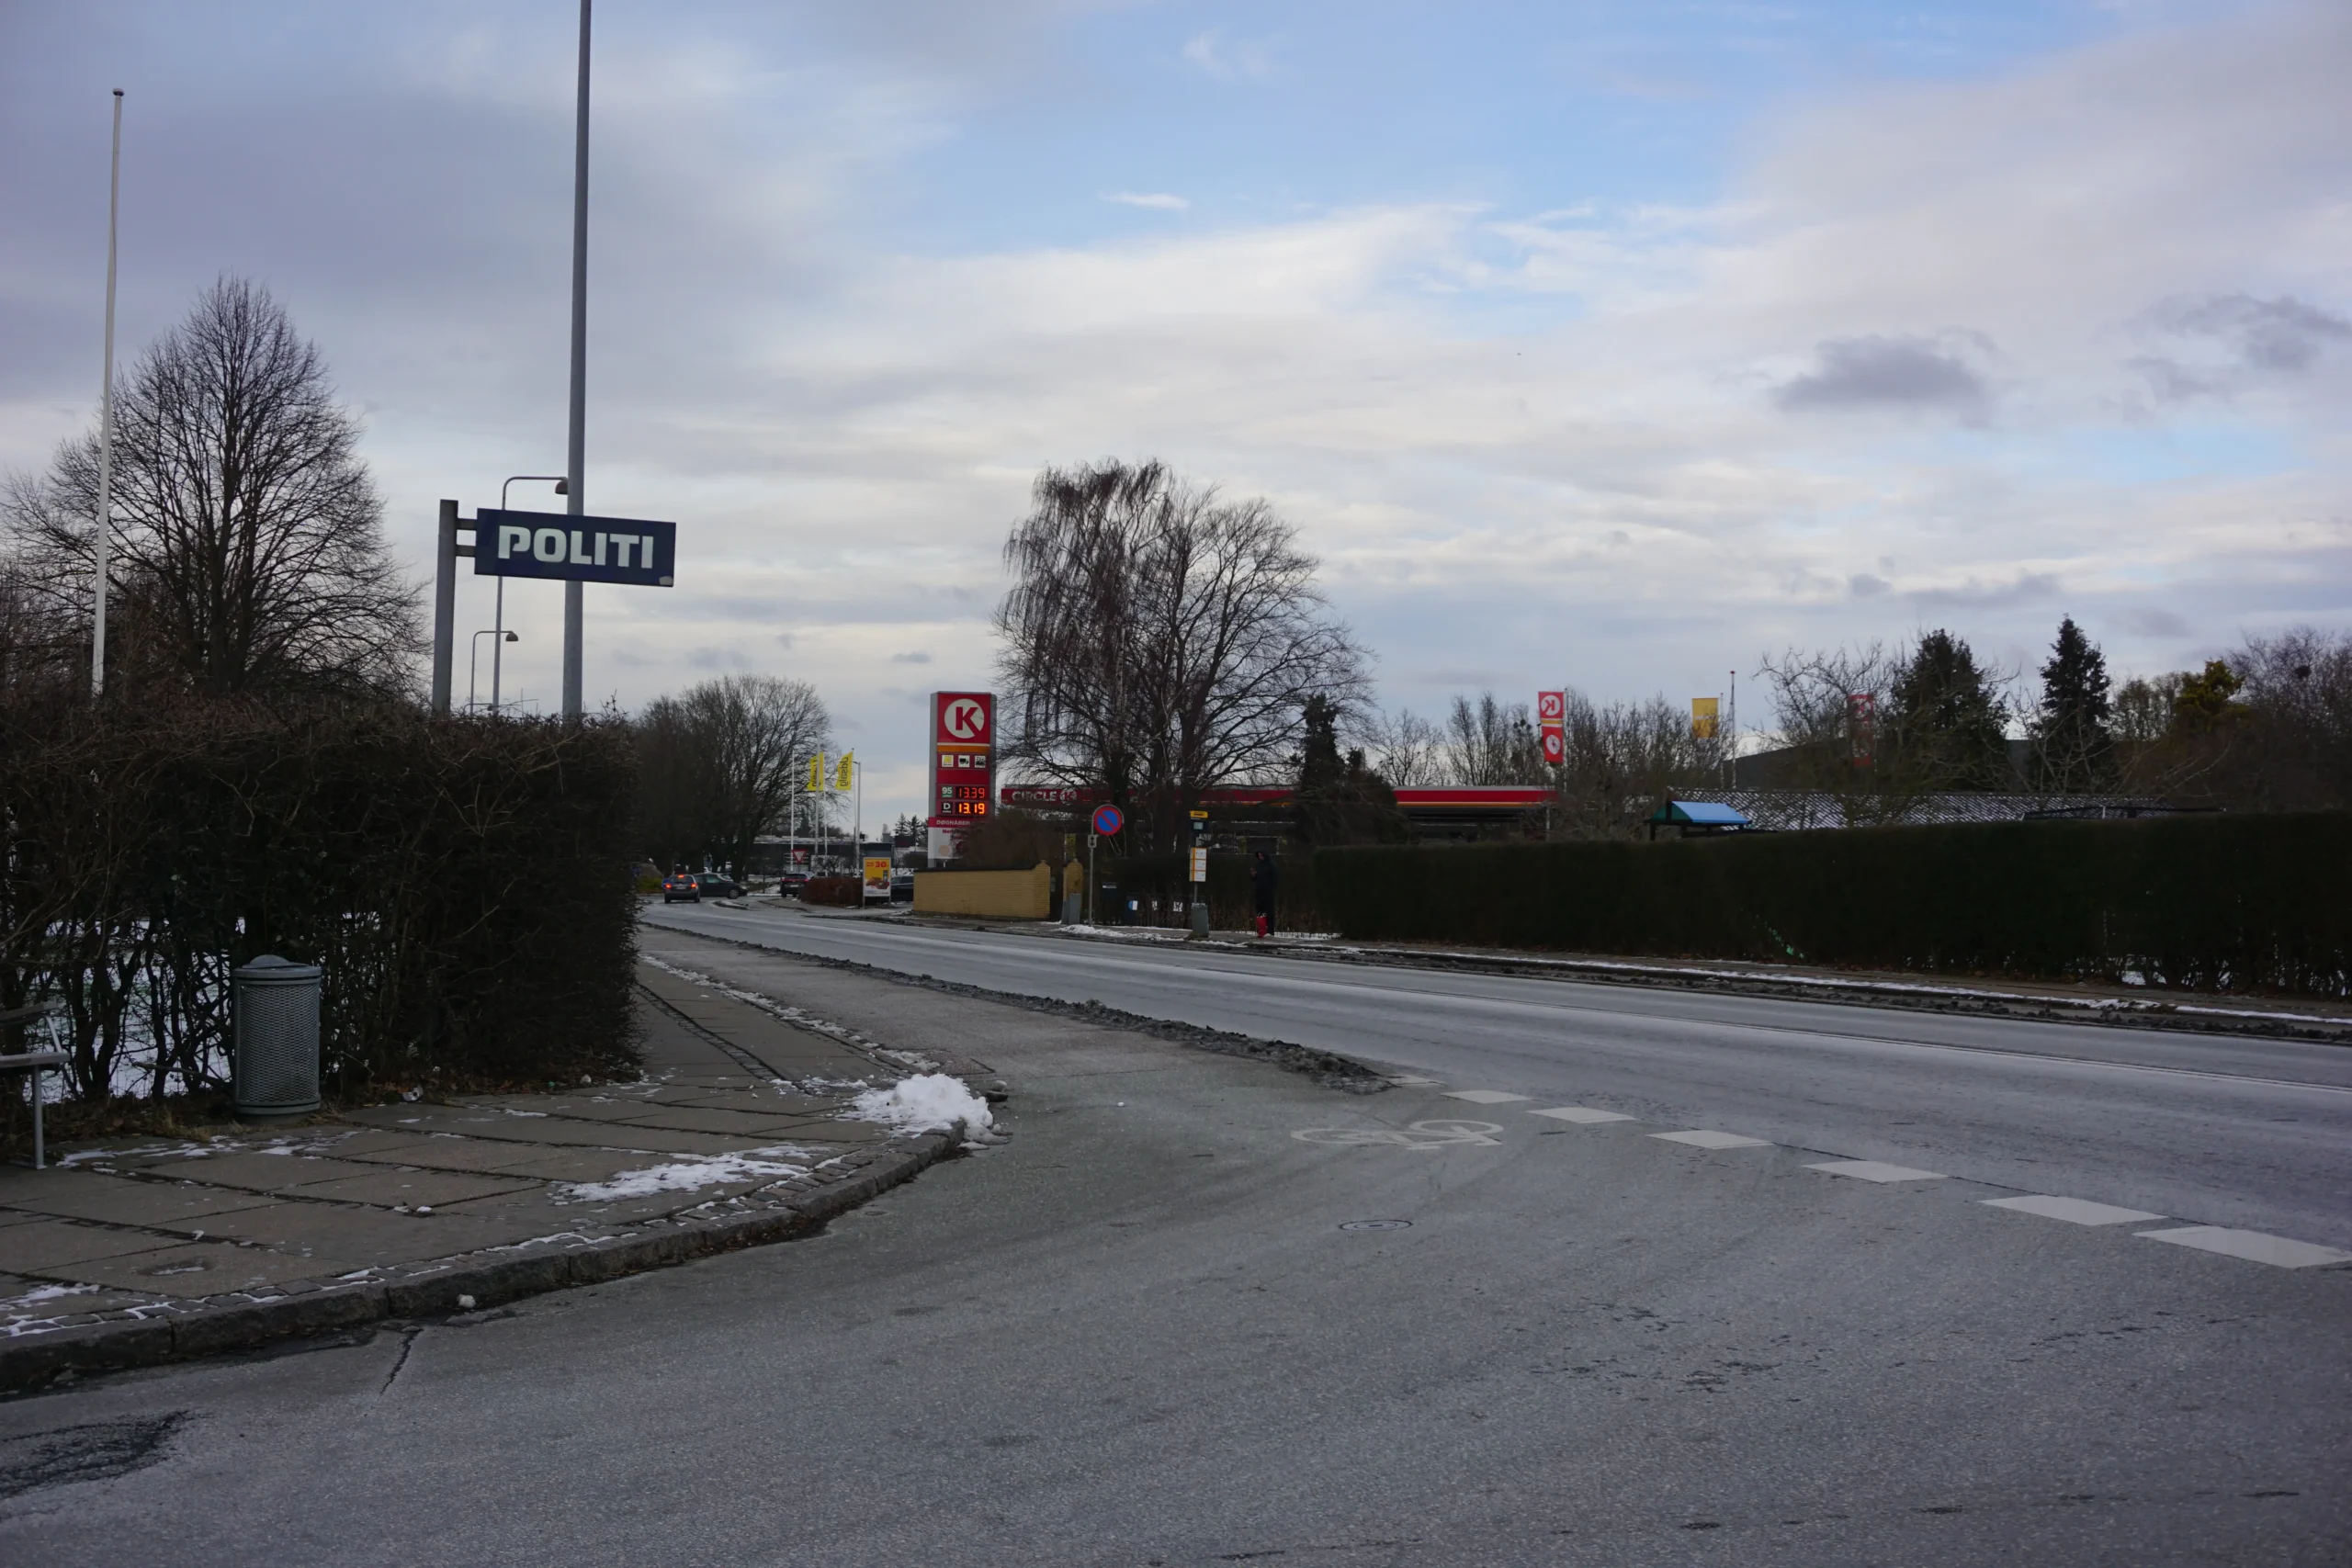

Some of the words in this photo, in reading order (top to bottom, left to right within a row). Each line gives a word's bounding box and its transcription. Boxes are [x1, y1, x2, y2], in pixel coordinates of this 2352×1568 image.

[498, 525, 654, 570] POLITI
[953, 704, 981, 737] K
[958, 787, 985, 798] 13.39
[1012, 790, 1057, 802] CIRCLE
[958, 803, 985, 814] 13.19
